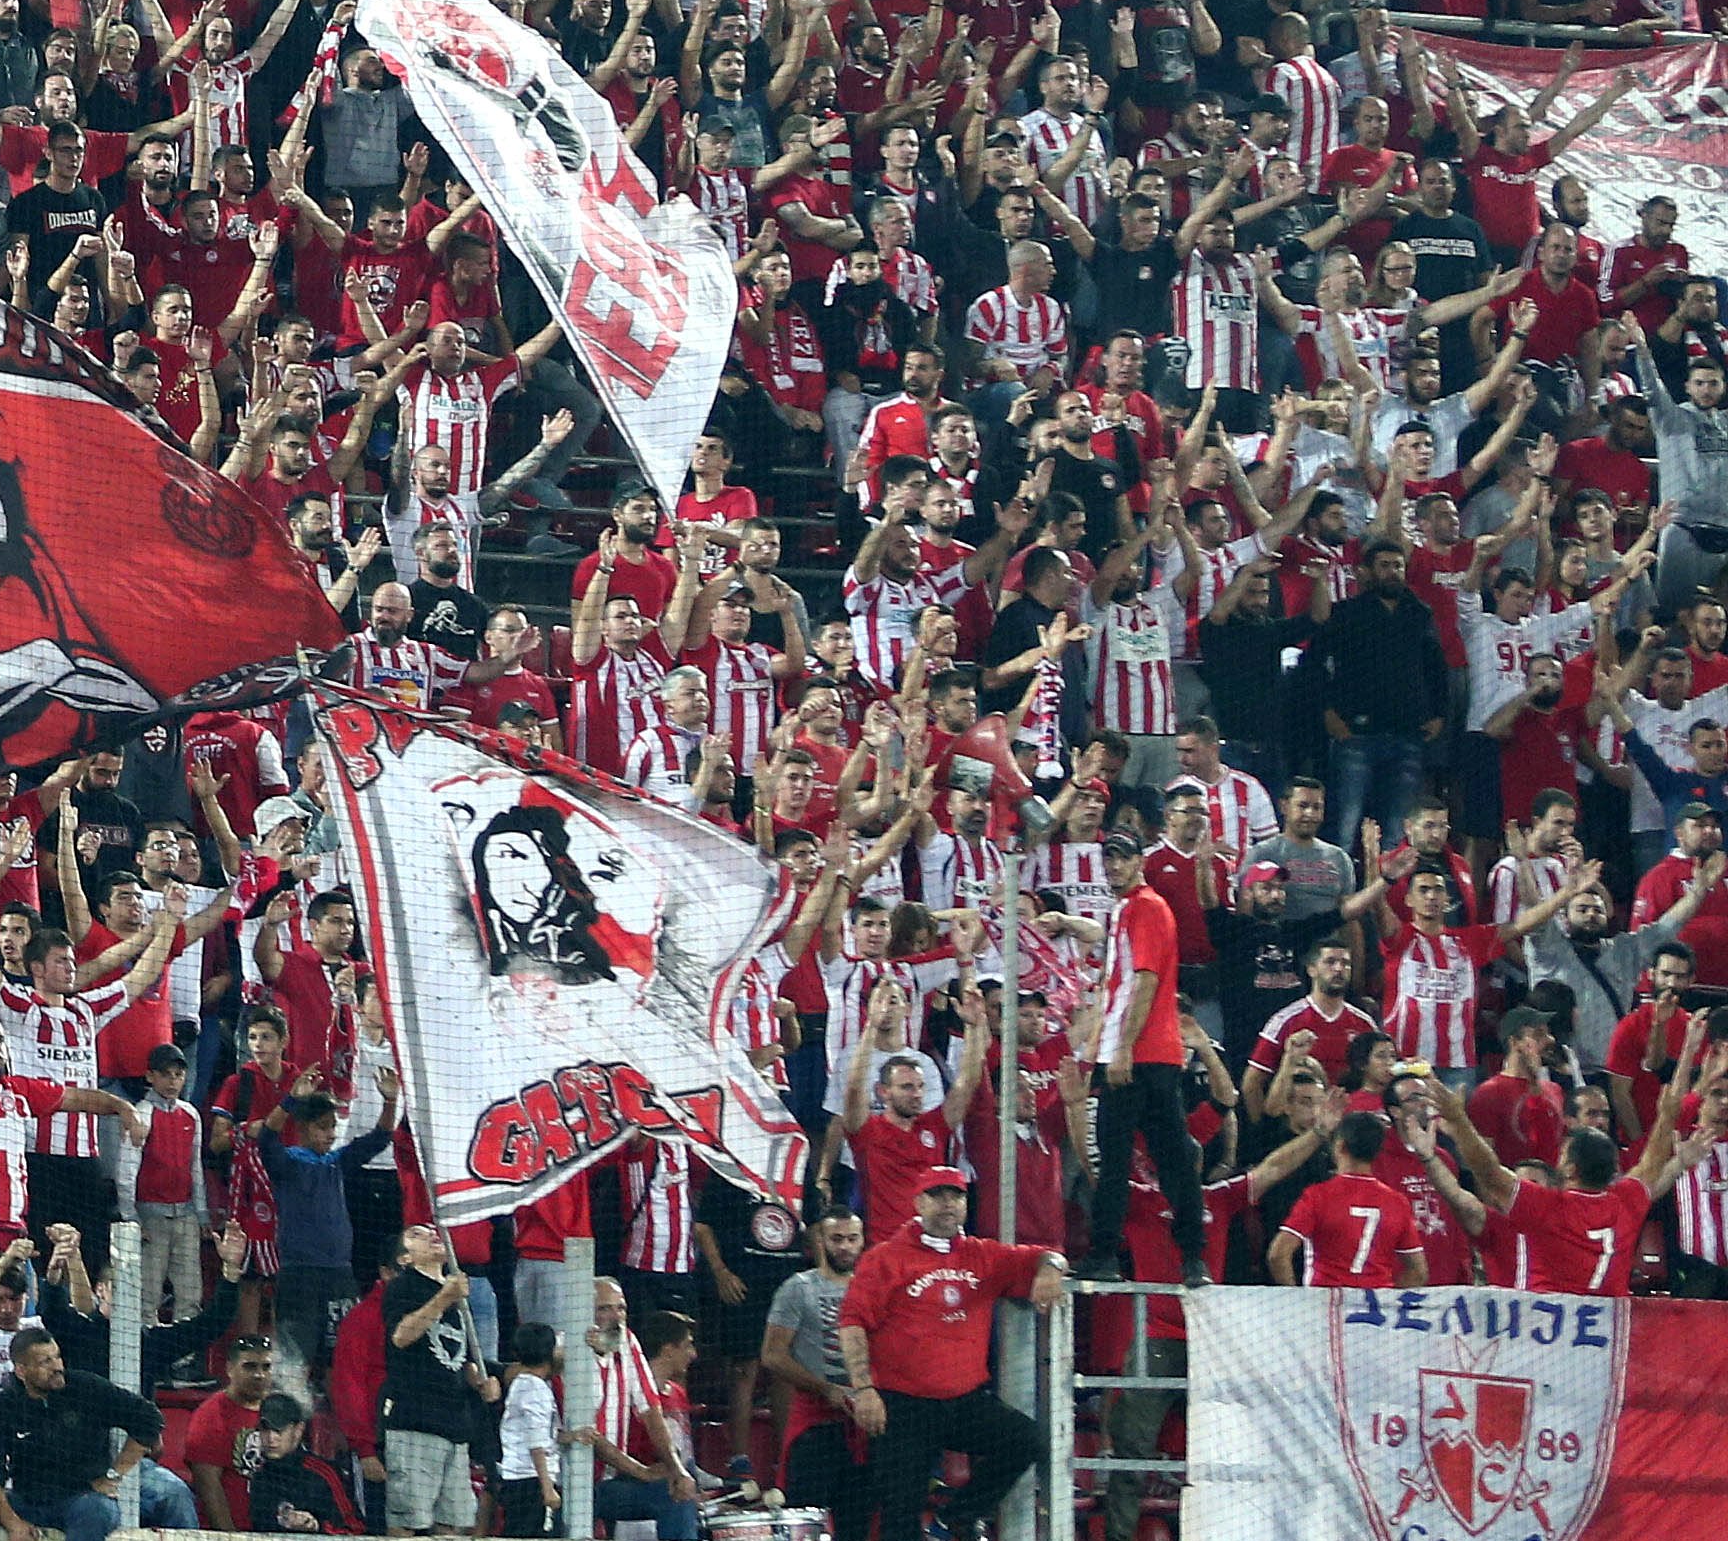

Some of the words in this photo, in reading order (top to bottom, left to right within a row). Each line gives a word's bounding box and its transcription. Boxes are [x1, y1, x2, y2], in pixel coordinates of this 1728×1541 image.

[1349, 1206, 1381, 1274] 7
[1586, 1227, 1616, 1290] 7
[1371, 1412, 1409, 1448] 19
[1536, 1427, 1581, 1463] 89
